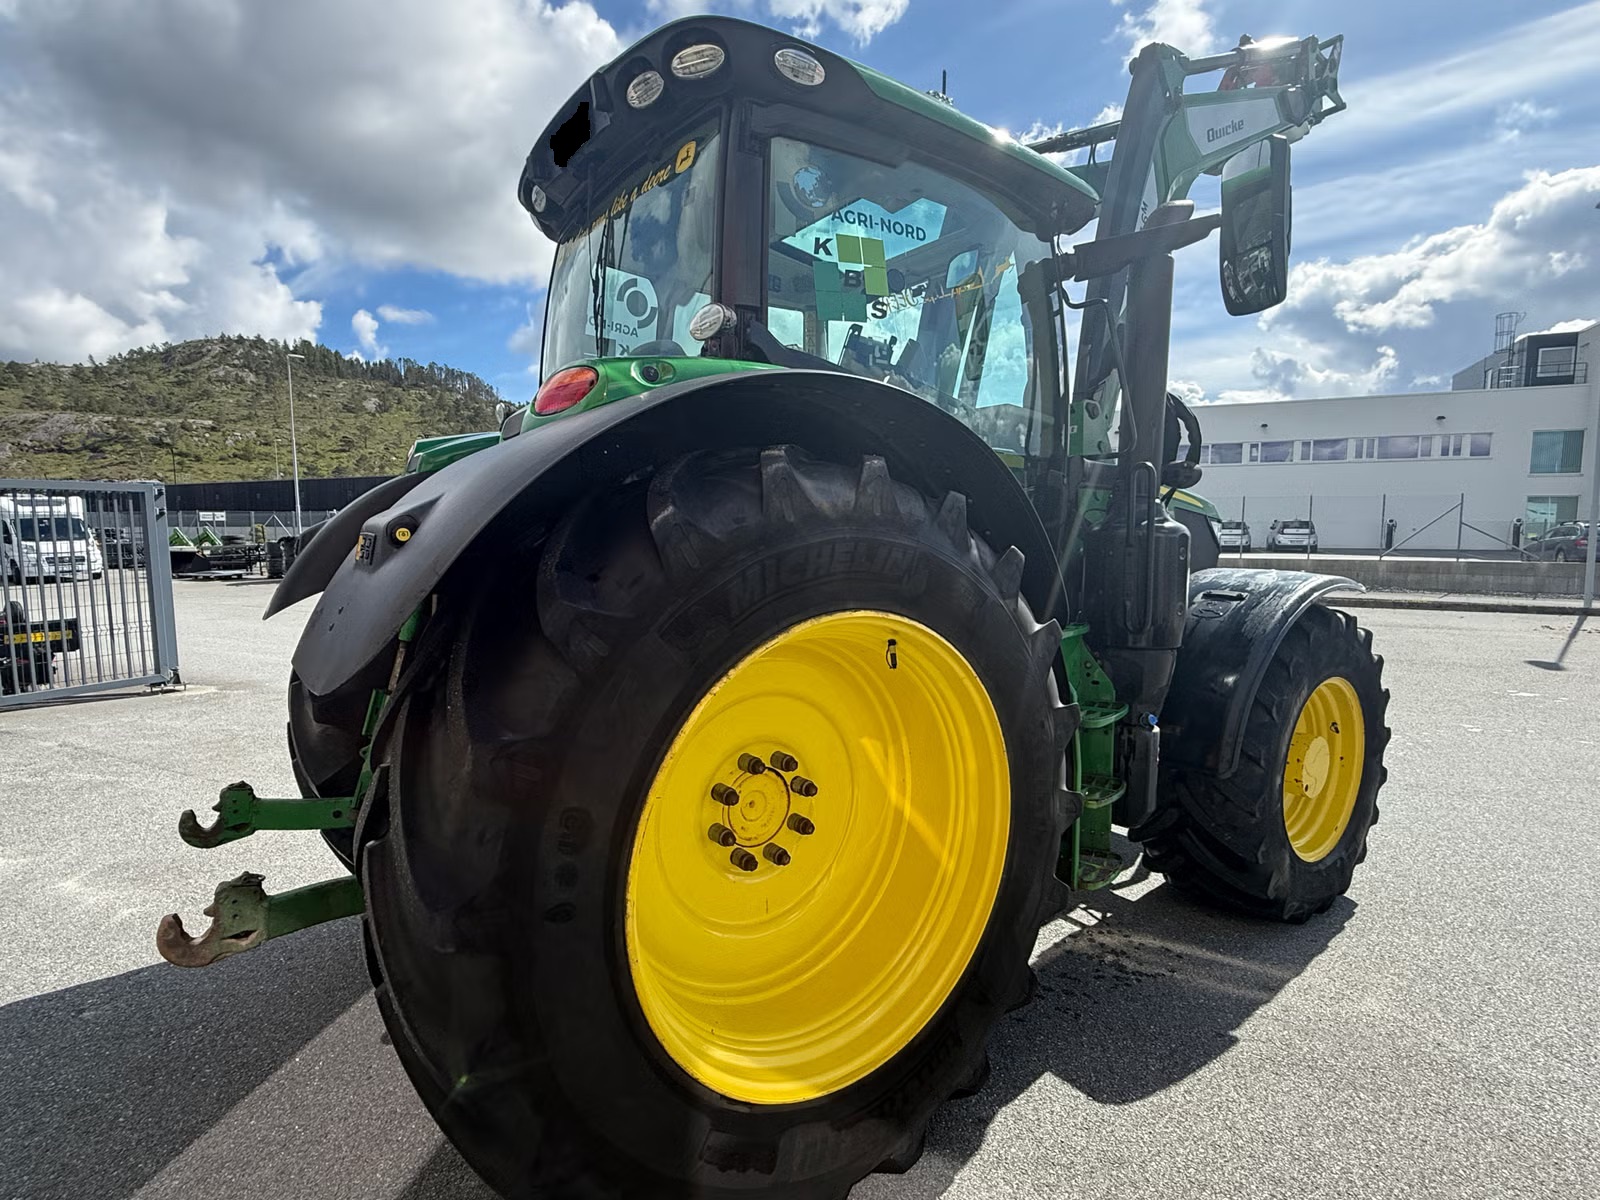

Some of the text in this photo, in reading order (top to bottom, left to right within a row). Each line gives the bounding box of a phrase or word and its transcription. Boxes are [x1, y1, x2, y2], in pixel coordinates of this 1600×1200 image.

[1206, 119, 1244, 143] Quicke
[641, 165, 672, 194] deere
[831, 209, 927, 241] AGRI-NORD
[813, 236, 833, 256] K
[844, 269, 864, 288] B
[871, 298, 888, 320] S
